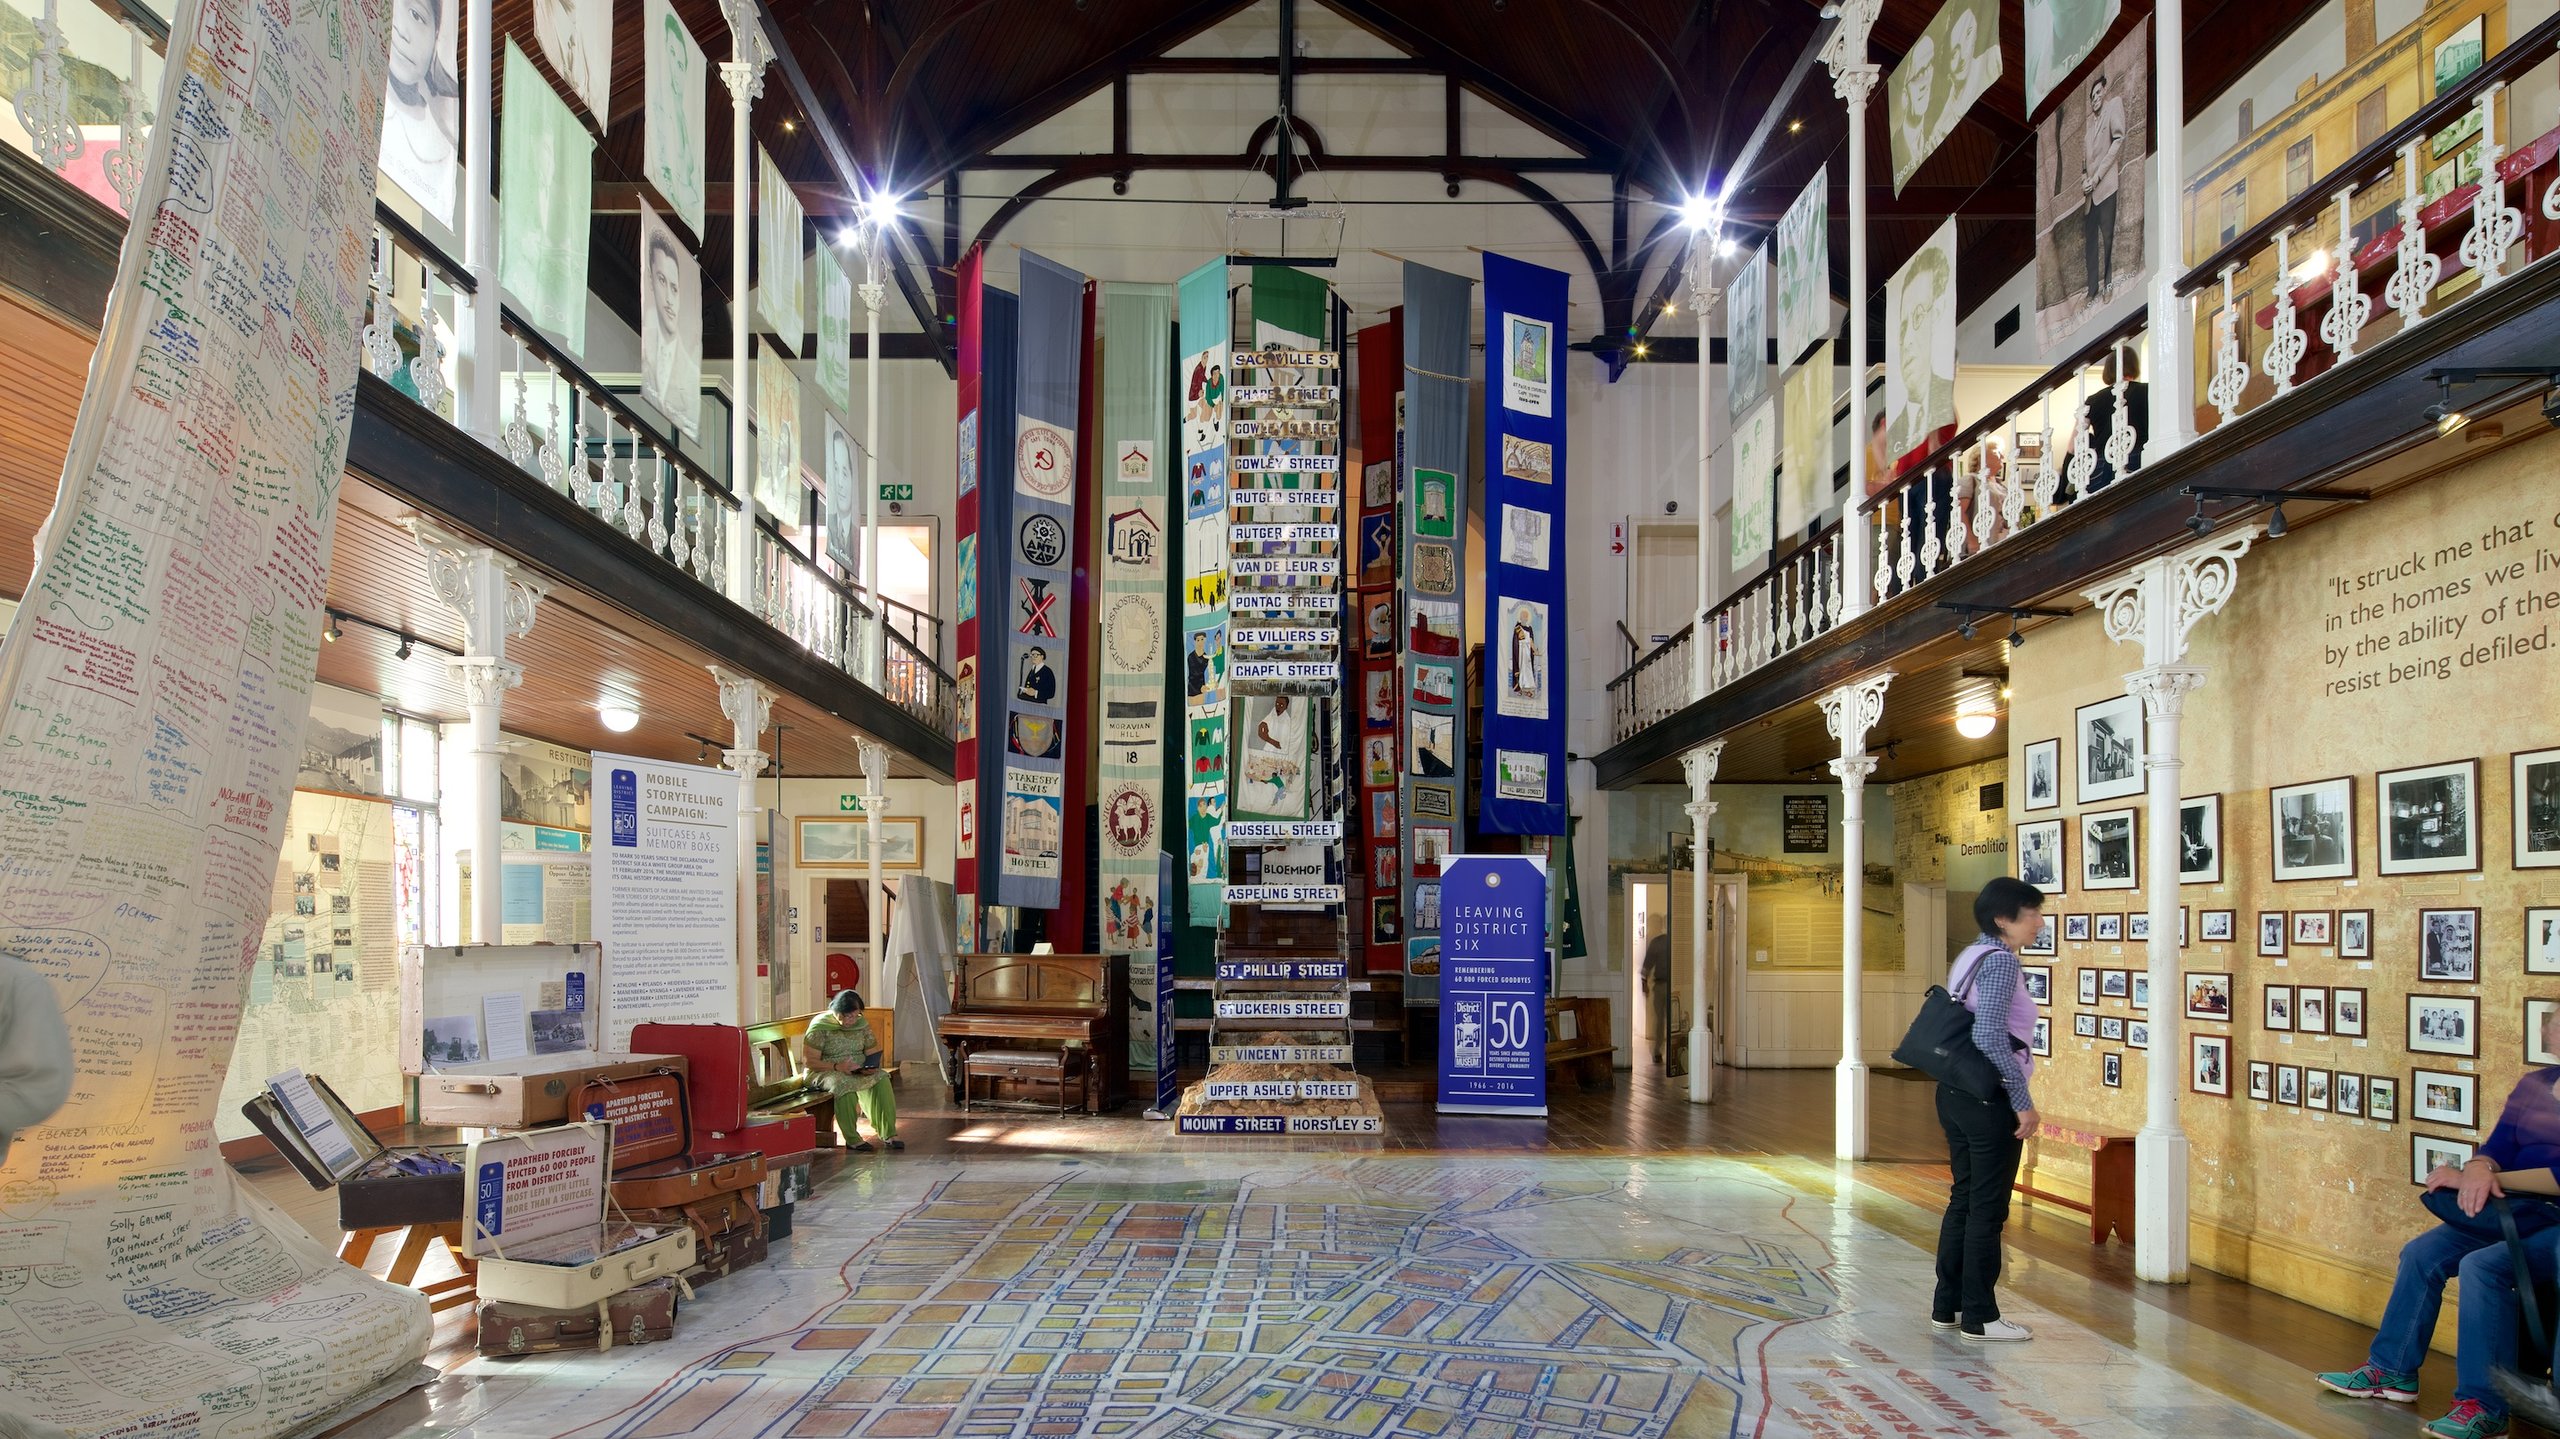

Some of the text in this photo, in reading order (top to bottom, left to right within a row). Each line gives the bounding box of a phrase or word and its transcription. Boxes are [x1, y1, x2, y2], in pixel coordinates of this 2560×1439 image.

[1235, 389, 1281, 401] CHAPE
[1234, 458, 1335, 470] COWLEY STREET
[1235, 492, 1335, 504] RUTGER STREET
[1236, 527, 1335, 539] RUTGER STREET
[1027, 539, 1056, 555] ANTI
[2356, 552, 2426, 590] struck
[2434, 541, 2473, 567] me
[2481, 519, 2534, 551] that
[1236, 561, 1260, 573] VAN
[1265, 561, 1280, 572] DE
[1286, 561, 1318, 572] LEUR
[1236, 597, 1335, 608] PONTAC STREET
[2326, 562, 2525, 632] in the homes we
[1237, 631, 1254, 642] DE
[1259, 631, 1316, 642] VILLIERS
[2325, 645, 2349, 668] by
[2356, 634, 2390, 657] the
[2398, 615, 2468, 646] ability
[2481, 597, 2508, 625] of
[2326, 624, 2556, 697] resist being defiled.
[1236, 665, 1334, 676] CHAPEL STREET
[1109, 722, 1151, 730] MORAVIAN
[1126, 751, 1138, 764] 18
[646, 773, 688, 788] MOBILE
[1008, 772, 1059, 785] STAKESBY
[1016, 782, 1048, 794] LEWIS
[646, 789, 723, 807] STORYTELLING
[646, 804, 708, 820] CAMPAIGN:
[623, 813, 635, 829] 50
[646, 827, 711, 841] SUITCASES AS
[1231, 825, 1336, 836] RUSSELL STREET
[646, 838, 721, 853] MEMORY BOXES
[1011, 857, 1050, 869] HOSTEL
[1264, 864, 1322, 875] BLOEMHOF
[1227, 888, 1339, 900] ASPELING STREET
[1455, 906, 1524, 919] LEAVING
[1455, 923, 1528, 935] DISTRICT
[1455, 939, 1480, 951] SIX
[1220, 964, 1344, 978] ST PHILLIP STREET
[1454, 966, 1495, 974] REMEMBERING
[1219, 1004, 1344, 1015] STUCKERIS STREET
[1456, 1002, 1480, 1013] District
[1462, 1013, 1473, 1023] Six
[1490, 1001, 1530, 1049] 50
[1236, 1049, 1288, 1060] VINCENT
[1295, 1049, 1343, 1060] STREET
[1210, 1085, 1353, 1096] UPPER ASHLEY STREET
[1469, 1081, 1514, 1090] 1966 2016
[606, 1090, 664, 1109] APARTHEID FORCIBLY
[606, 1097, 673, 1118] EVICTED 60 000 PEOPLE
[624, 1109, 662, 1123] DISTRICT SIX.
[1182, 1118, 1282, 1131] MOUNT STREET
[1293, 1118, 1359, 1131] HORSTLEY
[507, 1146, 586, 1168] APARTHEID FORCIBLY
[507, 1155, 596, 1180] EVICTED 60 000 PEOPLE
[506, 1169, 580, 1192] FROM DISTRICT SIX.
[480, 1182, 492, 1200] 50
[506, 1178, 590, 1204] MOST LEFT WITH LITTLE
[505, 1188, 595, 1216] MORE THAN A SUITCASE.
